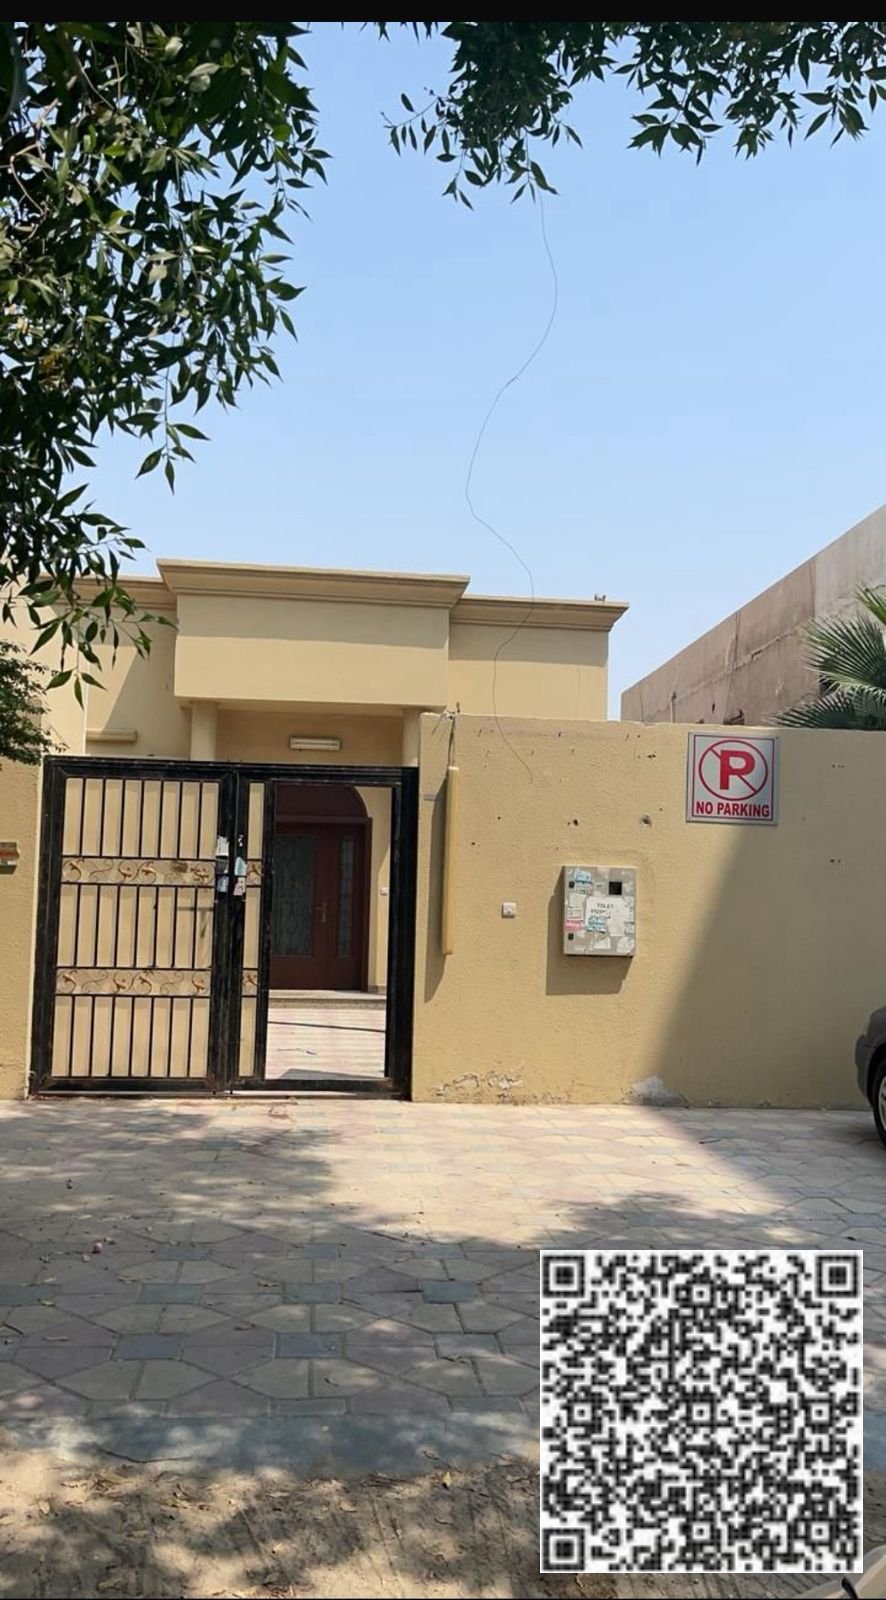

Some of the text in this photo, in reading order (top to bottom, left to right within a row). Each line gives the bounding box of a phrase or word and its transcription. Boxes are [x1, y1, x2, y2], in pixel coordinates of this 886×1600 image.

[720, 750, 755, 790] P
[696, 801, 769, 818] NO PARKING
